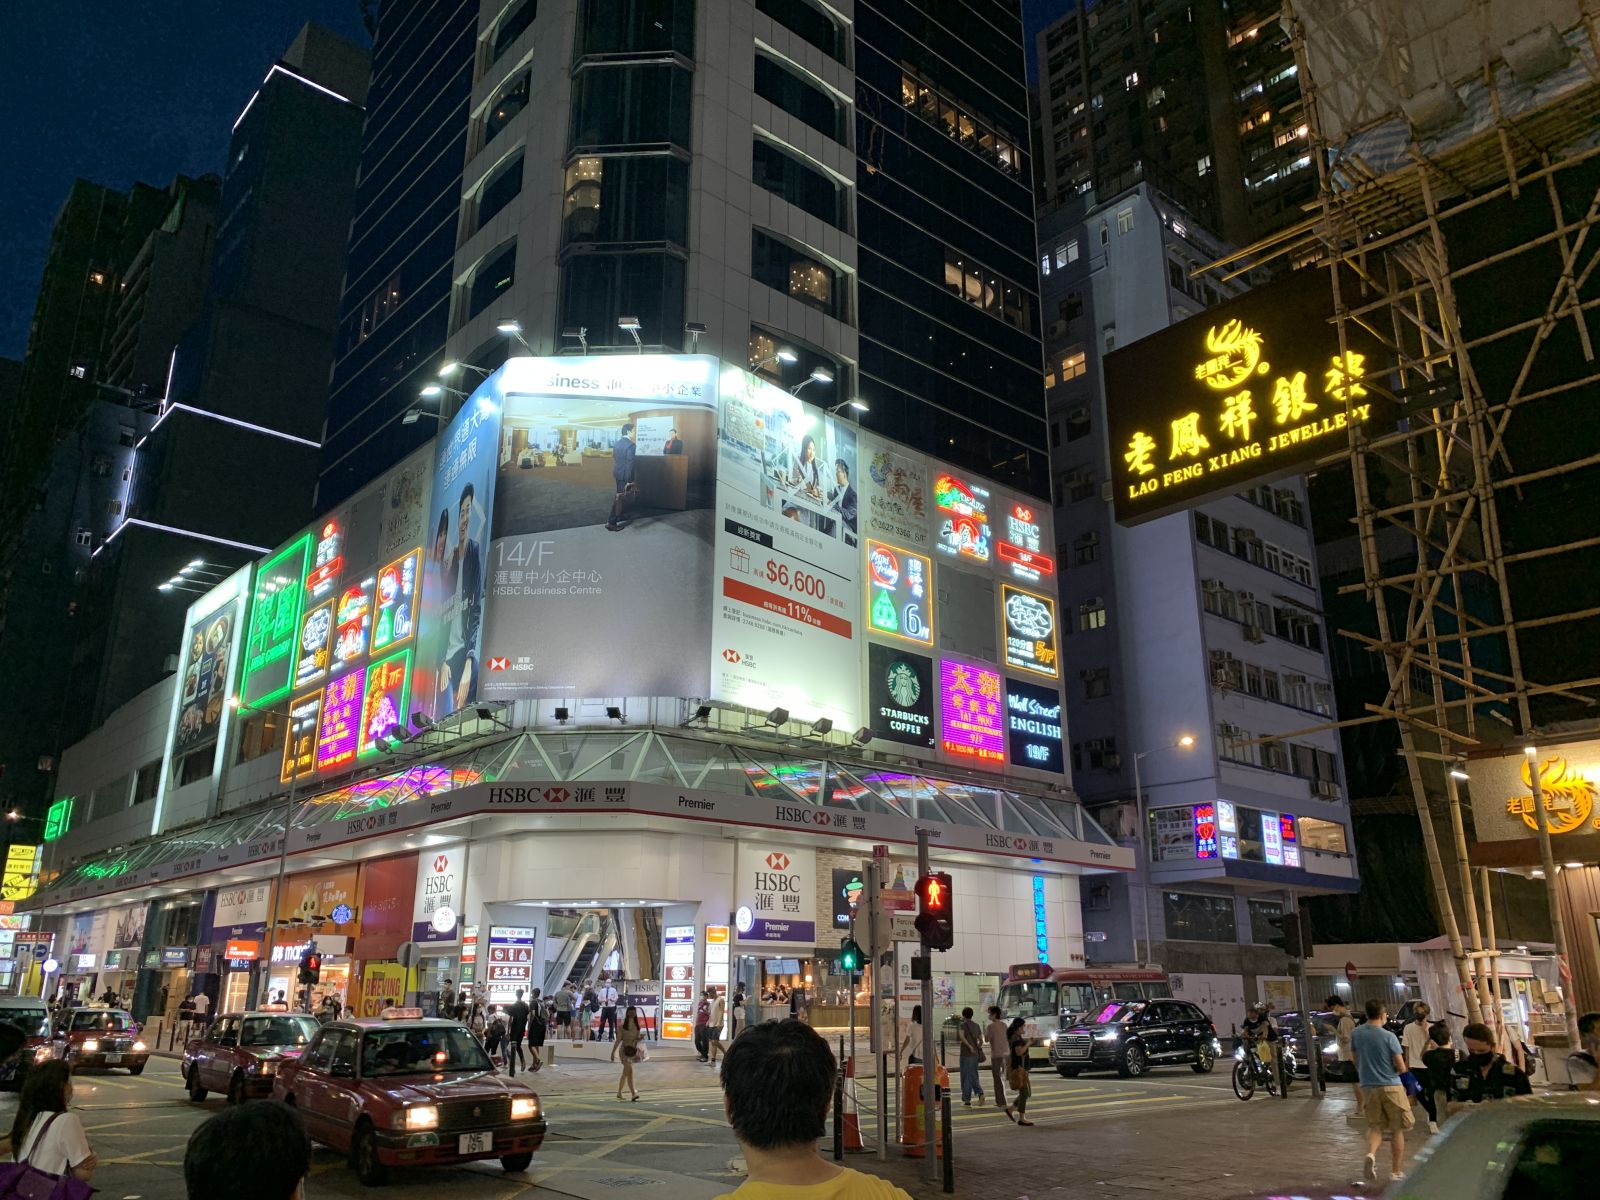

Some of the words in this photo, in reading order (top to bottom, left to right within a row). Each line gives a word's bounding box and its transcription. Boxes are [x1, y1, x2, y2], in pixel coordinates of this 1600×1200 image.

[1129, 478, 1158, 499] LAO
[1163, 462, 1203, 487] FENG
[1209, 442, 1262, 472] XIANG
[737, 526, 761, 541] 迎新獎賞
[1008, 515, 1040, 538] HSBC
[495, 540, 555, 567] 14/F
[494, 569, 603, 585] 滙豐中小企中心
[766, 558, 825, 600] $6,600
[492, 586, 521, 596] HSBC
[523, 585, 567, 596] Business
[569, 585, 602, 595] Centre
[787, 601, 812, 622] 11%
[880, 706, 929, 725] STARBUCKS
[1008, 694, 1028, 710] Wall
[1028, 697, 1061, 719] Street
[890, 721, 921, 735] COFFEE
[1010, 716, 1062, 739] ENGLISH
[1025, 742, 1051, 762] 19/F
[488, 787, 541, 804] HSBC
[574, 787, 626, 803] 滙豐
[678, 795, 715, 811] Premier
[430, 801, 452, 814] Premier
[347, 820, 367, 835] HSBC
[775, 806, 811, 824] HSBC
[833, 813, 866, 831] 滙豐
[306, 832, 321, 844] Premier
[986, 834, 1012, 849] HSBC
[1029, 840, 1053, 854] 滙豐
[1090, 849, 1111, 861] Premier
[425, 874, 454, 895] HSBC
[755, 872, 800, 893] HSBC
[220, 891, 238, 908] HSBC
[755, 893, 800, 913] 滙豐
[765, 922, 789, 932] Premier
[635, 984, 657, 992] HSBC
[469, 1132, 483, 1143] NE
